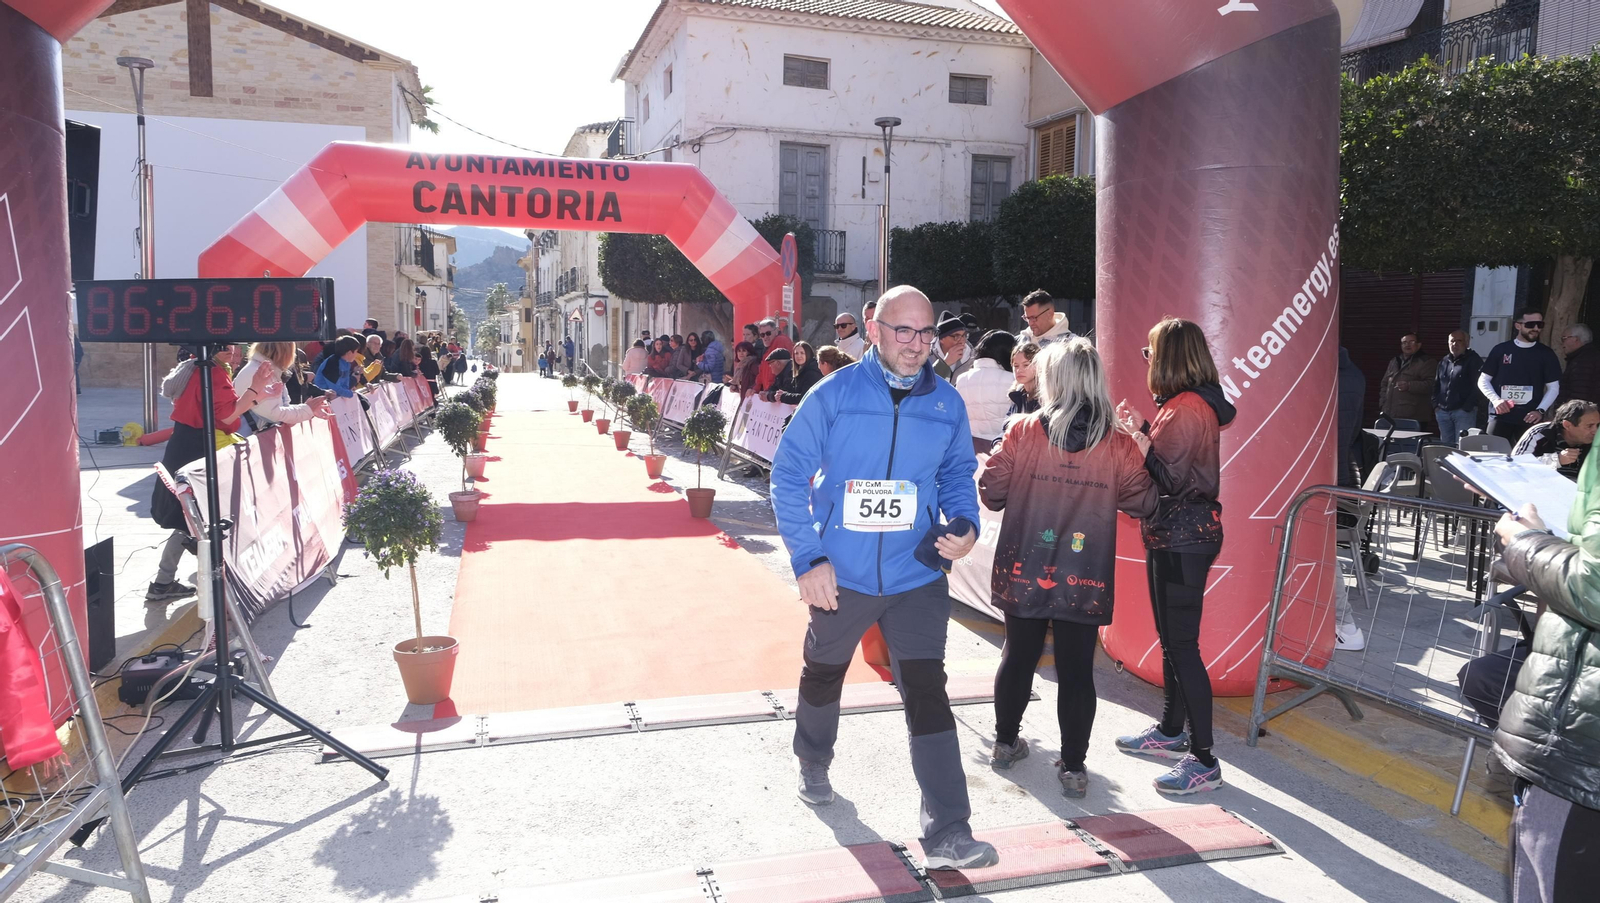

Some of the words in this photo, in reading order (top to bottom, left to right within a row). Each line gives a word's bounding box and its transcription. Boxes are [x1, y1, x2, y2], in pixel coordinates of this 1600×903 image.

[405, 151, 630, 182] AYUNTAMIENTO
[412, 180, 623, 223] CANTORIA
[1507, 391, 1526, 400] 357
[752, 408, 784, 425] AYUNTAMIENT
[746, 418, 781, 446] CANTOR
[1030, 473, 1049, 482] VALLE
[1065, 478, 1109, 490] ALMANZORA
[859, 498, 902, 518] 545
[1079, 578, 1105, 588] VEOLIA
